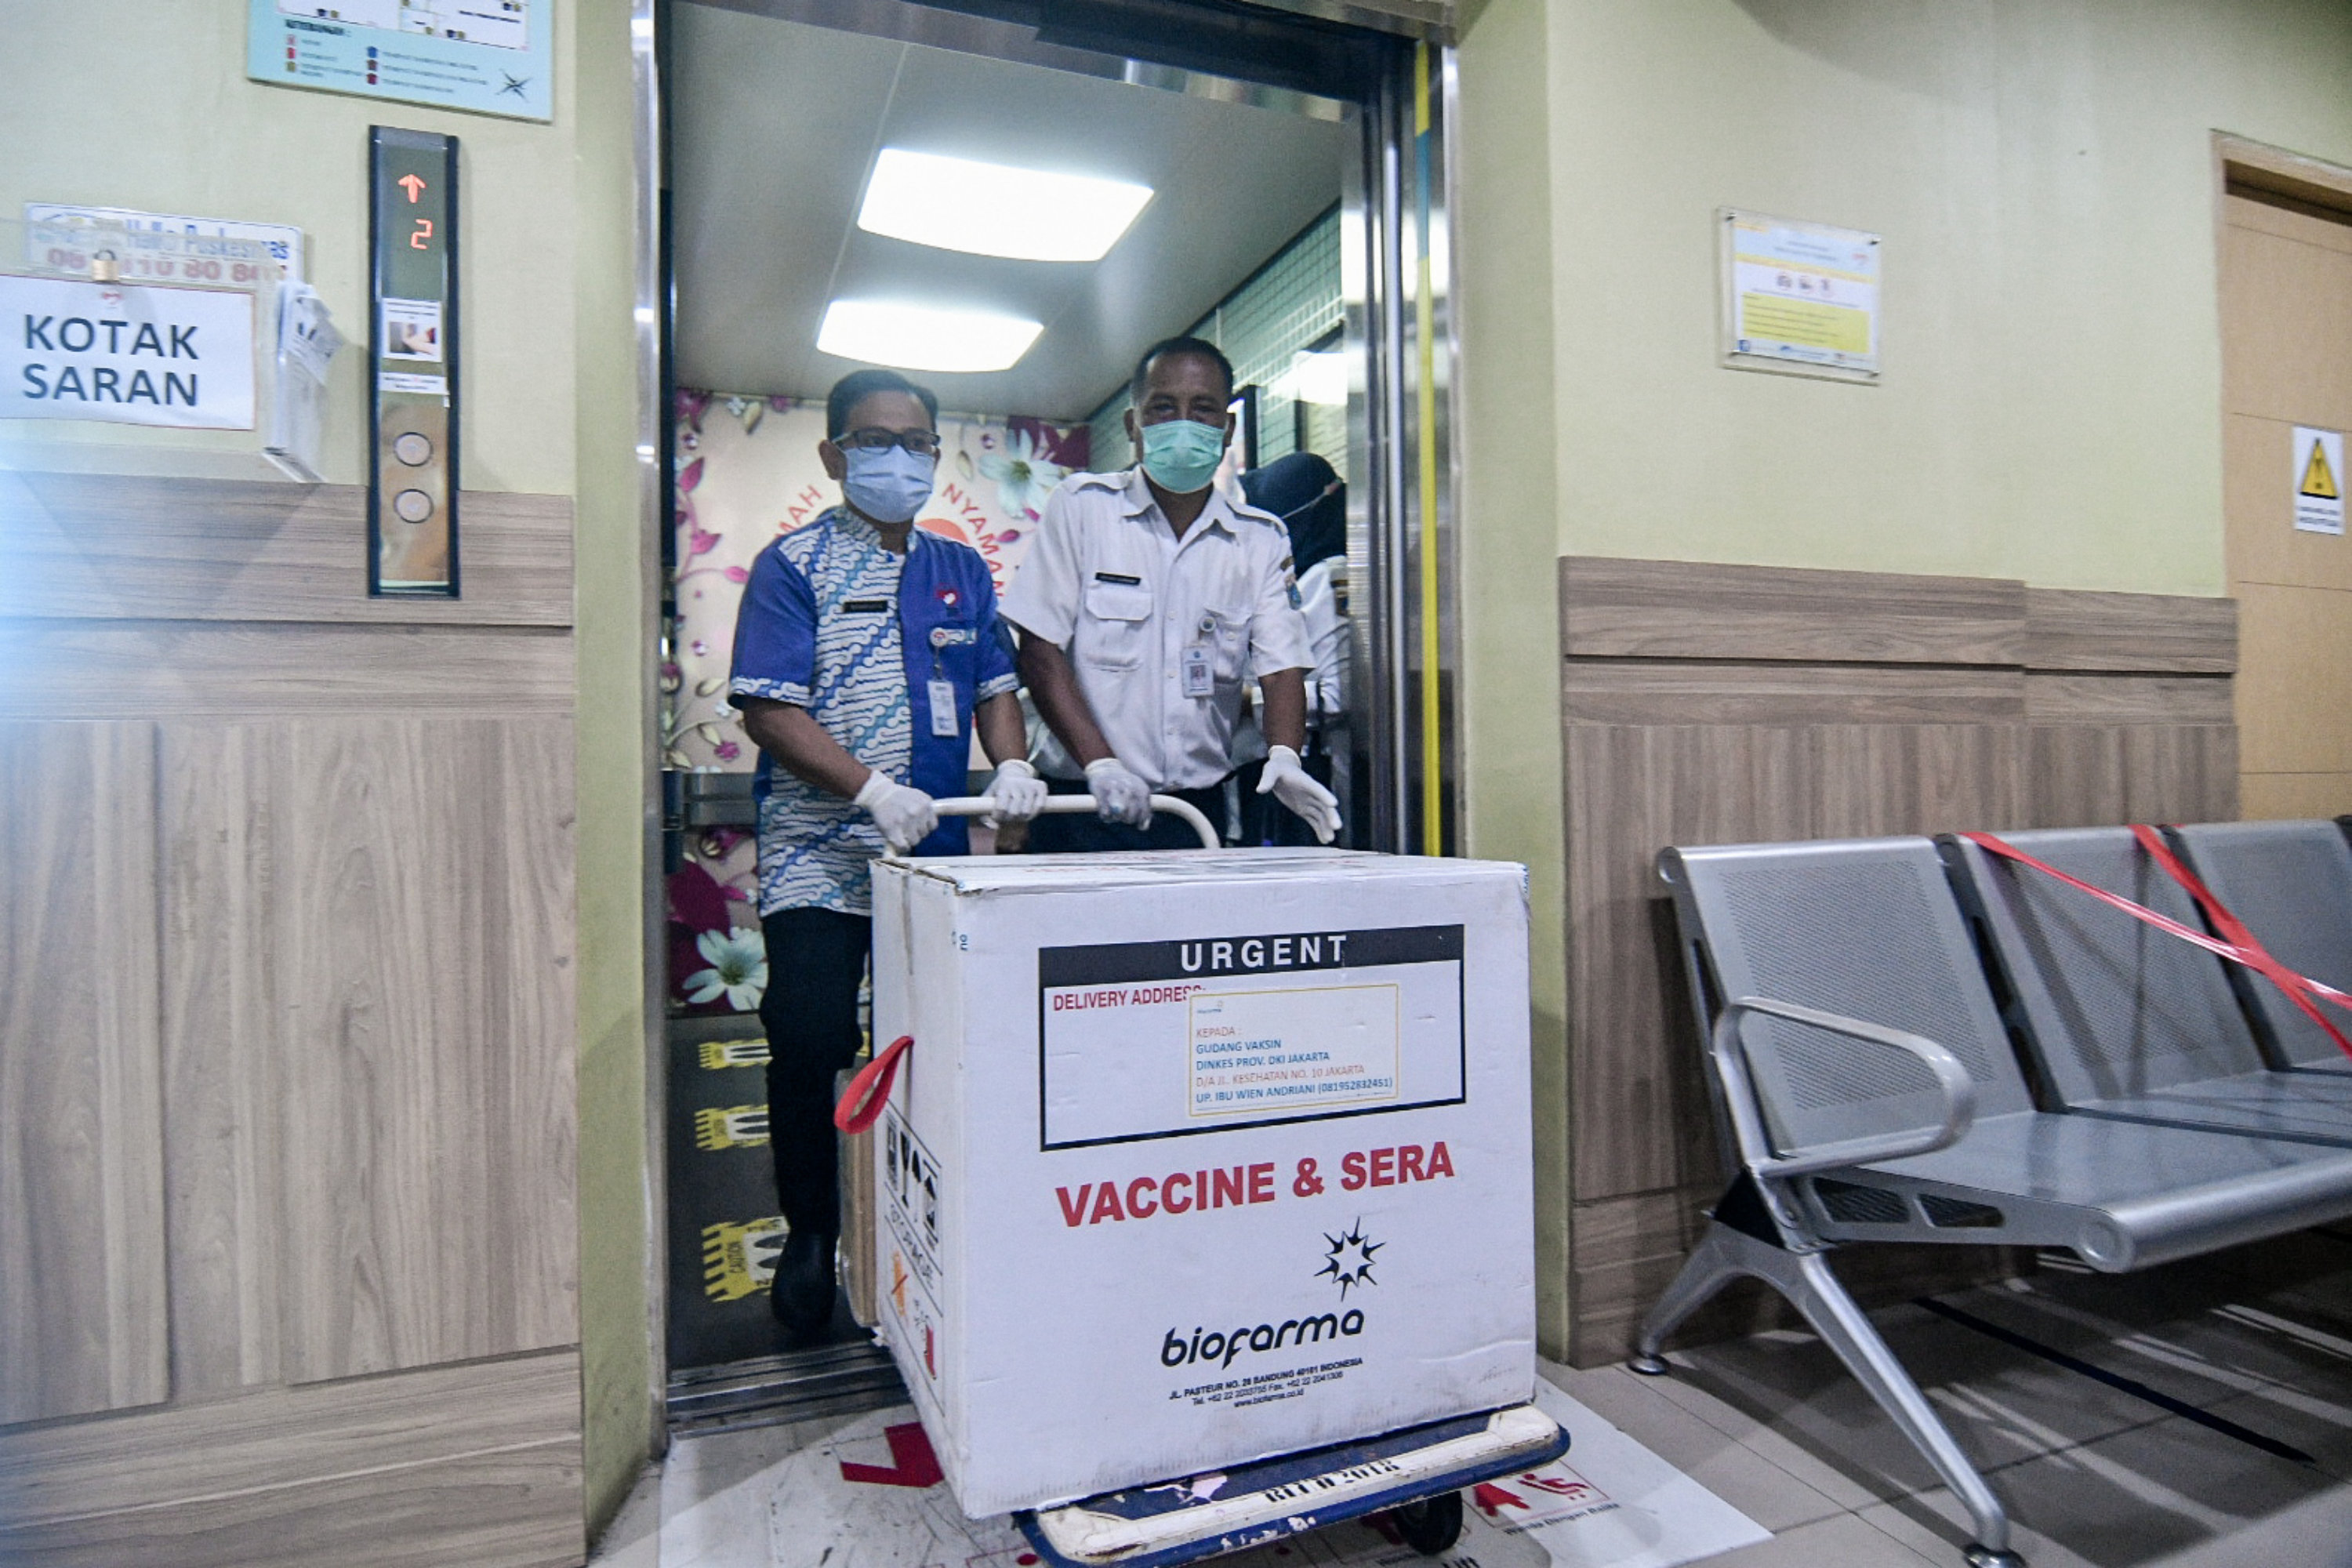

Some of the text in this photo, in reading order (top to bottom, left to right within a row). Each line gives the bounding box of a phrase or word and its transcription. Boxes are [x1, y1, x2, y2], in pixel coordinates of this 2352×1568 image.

[411, 219, 433, 249] 2
[24, 314, 200, 361] KOTAK
[22, 362, 198, 407] SARAN
[1181, 934, 1348, 972] URGENT
[1053, 989, 1127, 1011] DELIVERY
[1196, 1025, 1236, 1038] KEPADA
[1196, 1039, 1282, 1054] GUDANG VAKSIN
[1196, 1051, 1330, 1071] DINKES PROV. DKI JAKARTA
[1232, 1070, 1289, 1084] KESEHATAN
[1324, 1064, 1365, 1077] JAKARTA
[1215, 1091, 1233, 1102] IBU
[1235, 1088, 1264, 1100] WIEN
[1266, 1084, 1316, 1097] ANDRIANI
[1055, 1141, 1456, 1228] VACCINE & SERA
[1160, 1308, 1365, 1370] biofarma
[1184, 1382, 1223, 1396] PASTEUR
[1253, 1370, 1295, 1385] BANDUNG
[1319, 1357, 1363, 1373] INDONESIA
[1223, 1391, 1234, 1401] 22
[1301, 1376, 1311, 1386] 22
